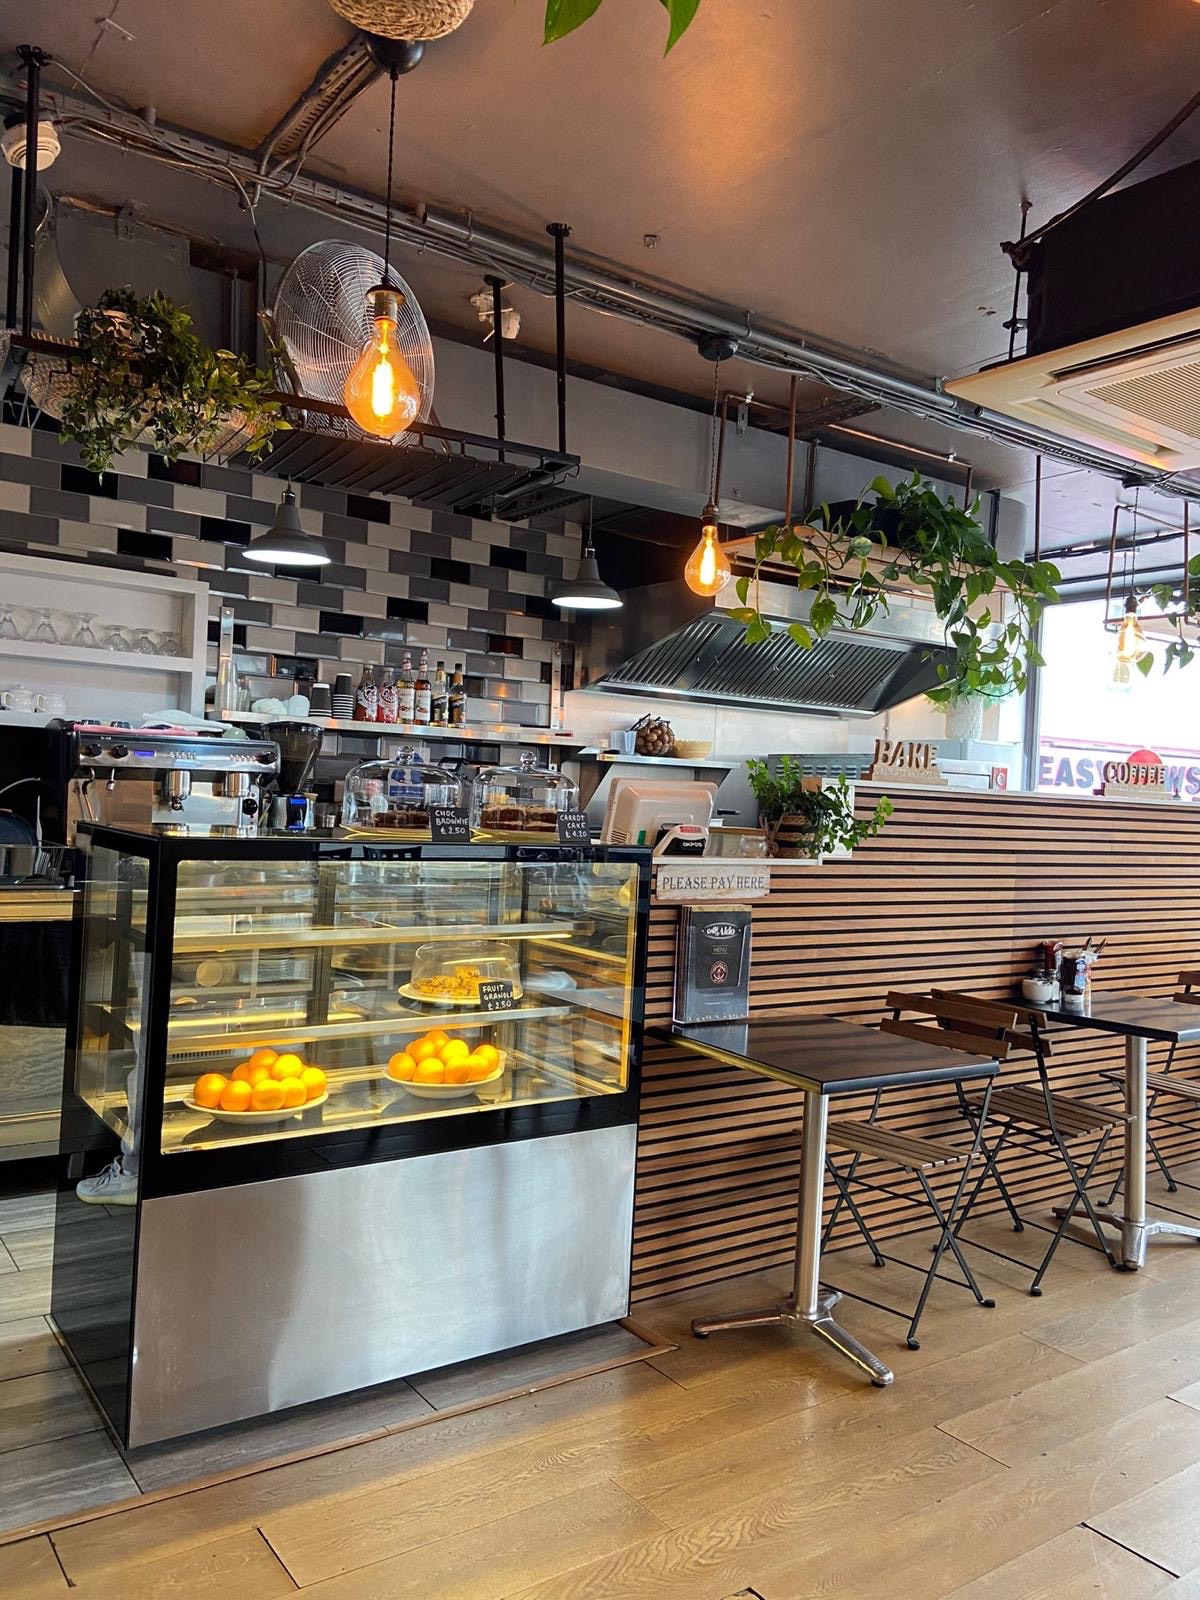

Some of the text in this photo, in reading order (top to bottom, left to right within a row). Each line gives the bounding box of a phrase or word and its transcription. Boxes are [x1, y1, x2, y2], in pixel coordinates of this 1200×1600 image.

[874, 739, 938, 769] BAKE
[1103, 761, 1165, 785] COFFEE
[436, 817, 469, 825] BROWNIE
[662, 875, 765, 890] PLEASE PAY HERE
[482, 984, 504, 993] FRUIT
